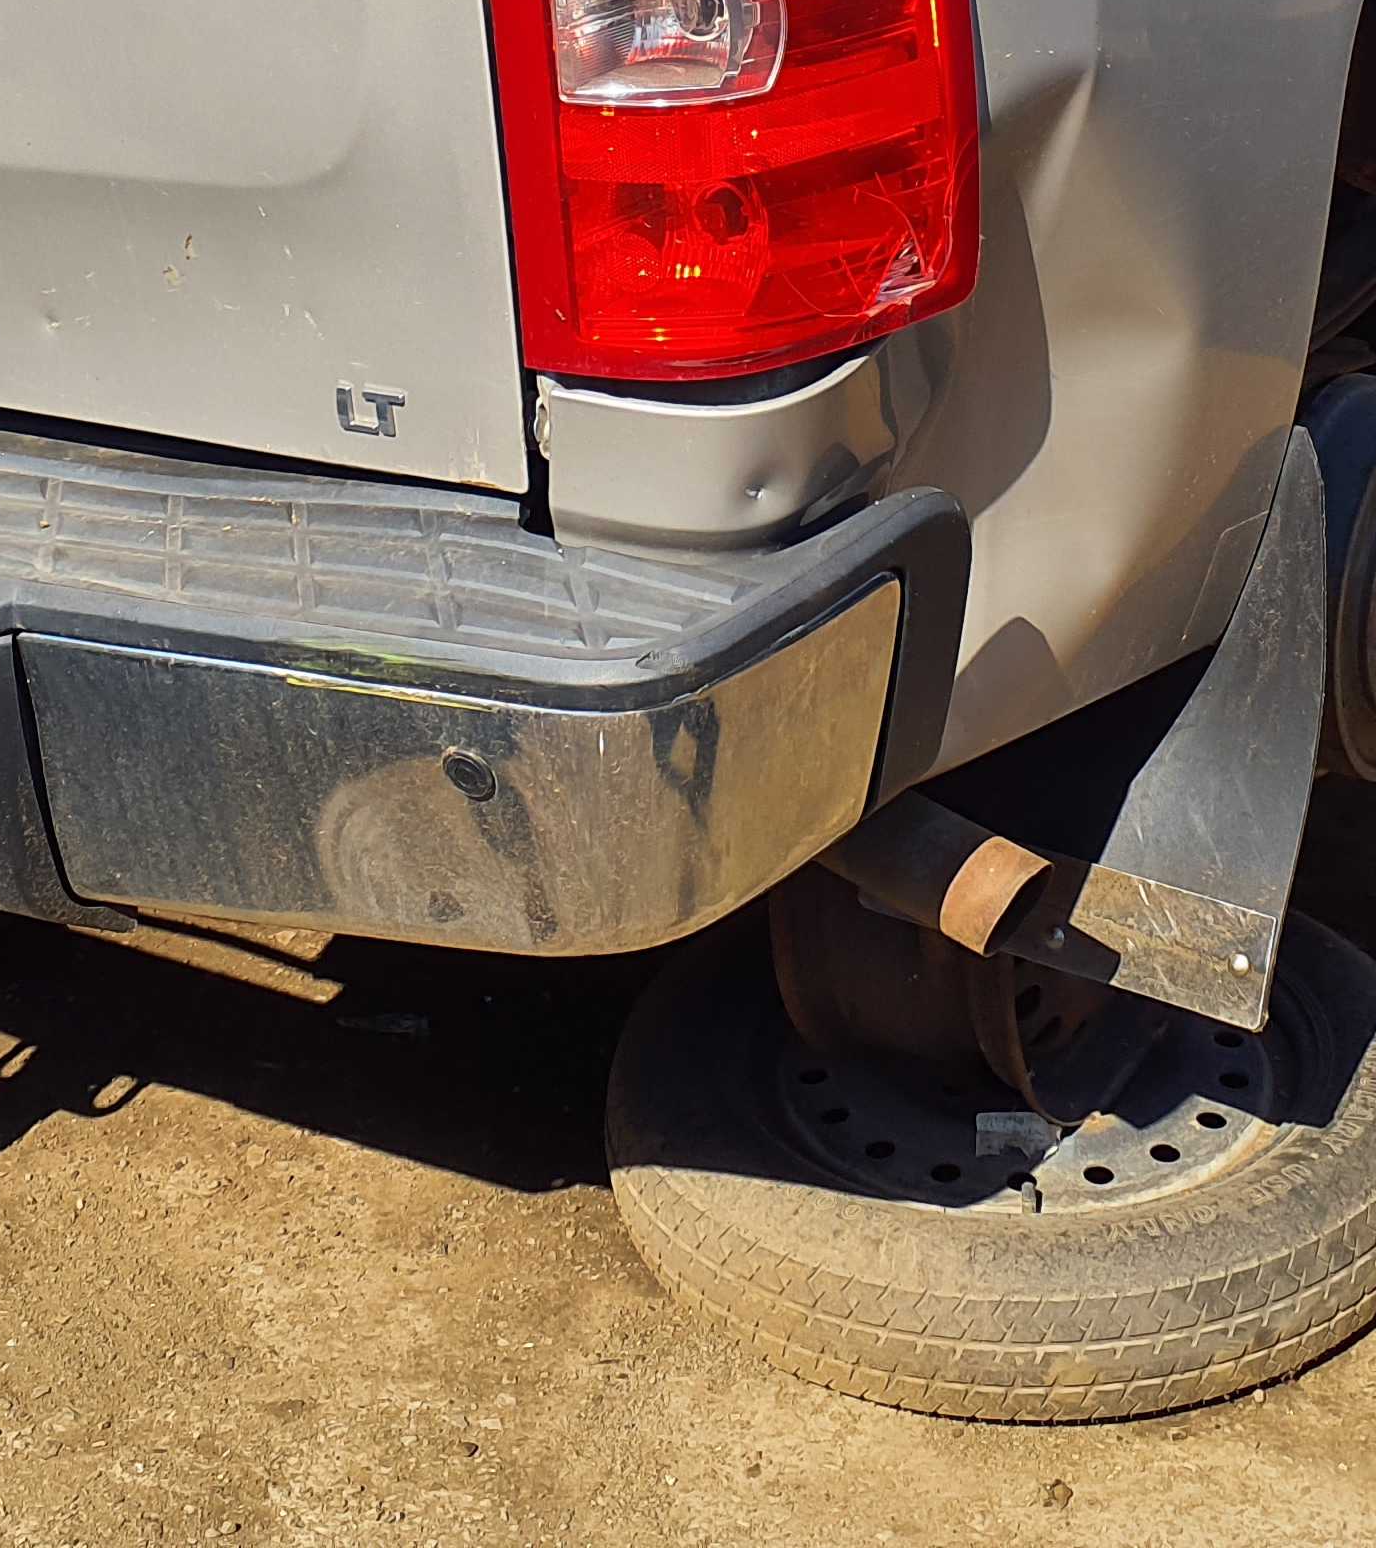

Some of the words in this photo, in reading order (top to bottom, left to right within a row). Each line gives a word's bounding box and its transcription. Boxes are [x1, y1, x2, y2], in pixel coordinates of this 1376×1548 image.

[335, 386, 406, 438] LT
[1243, 1162, 1314, 1204] USE
[1103, 1203, 1221, 1242] ONLY
